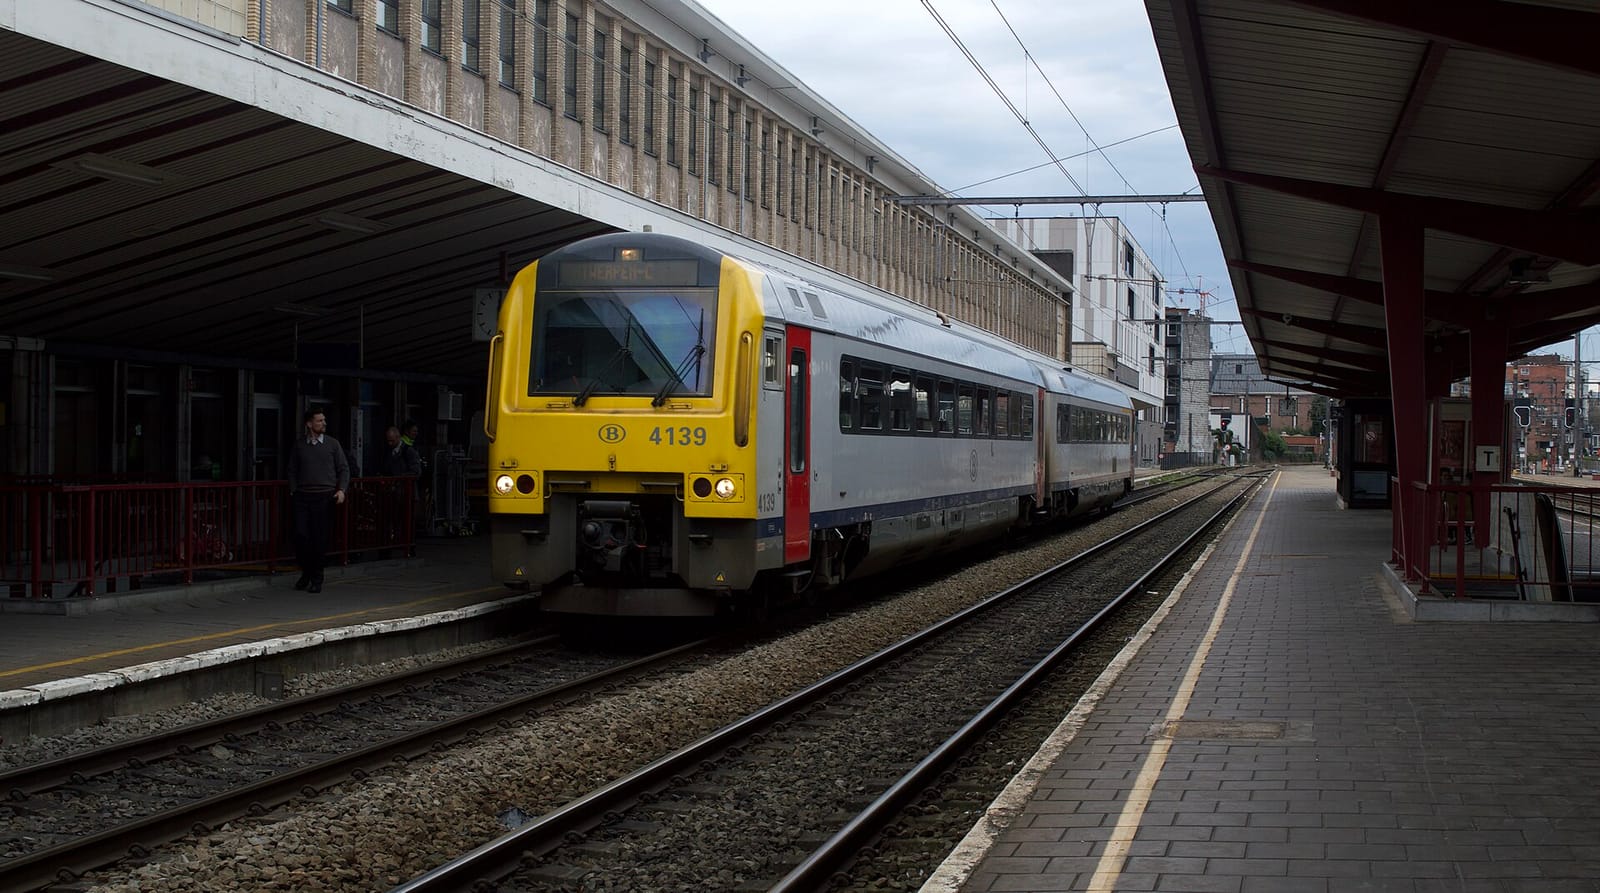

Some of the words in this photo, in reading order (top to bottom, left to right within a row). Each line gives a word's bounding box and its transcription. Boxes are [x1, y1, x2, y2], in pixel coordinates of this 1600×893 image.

[649, 427, 706, 446] 4139
[1483, 451, 1494, 465] T
[758, 493, 774, 512] 4139
